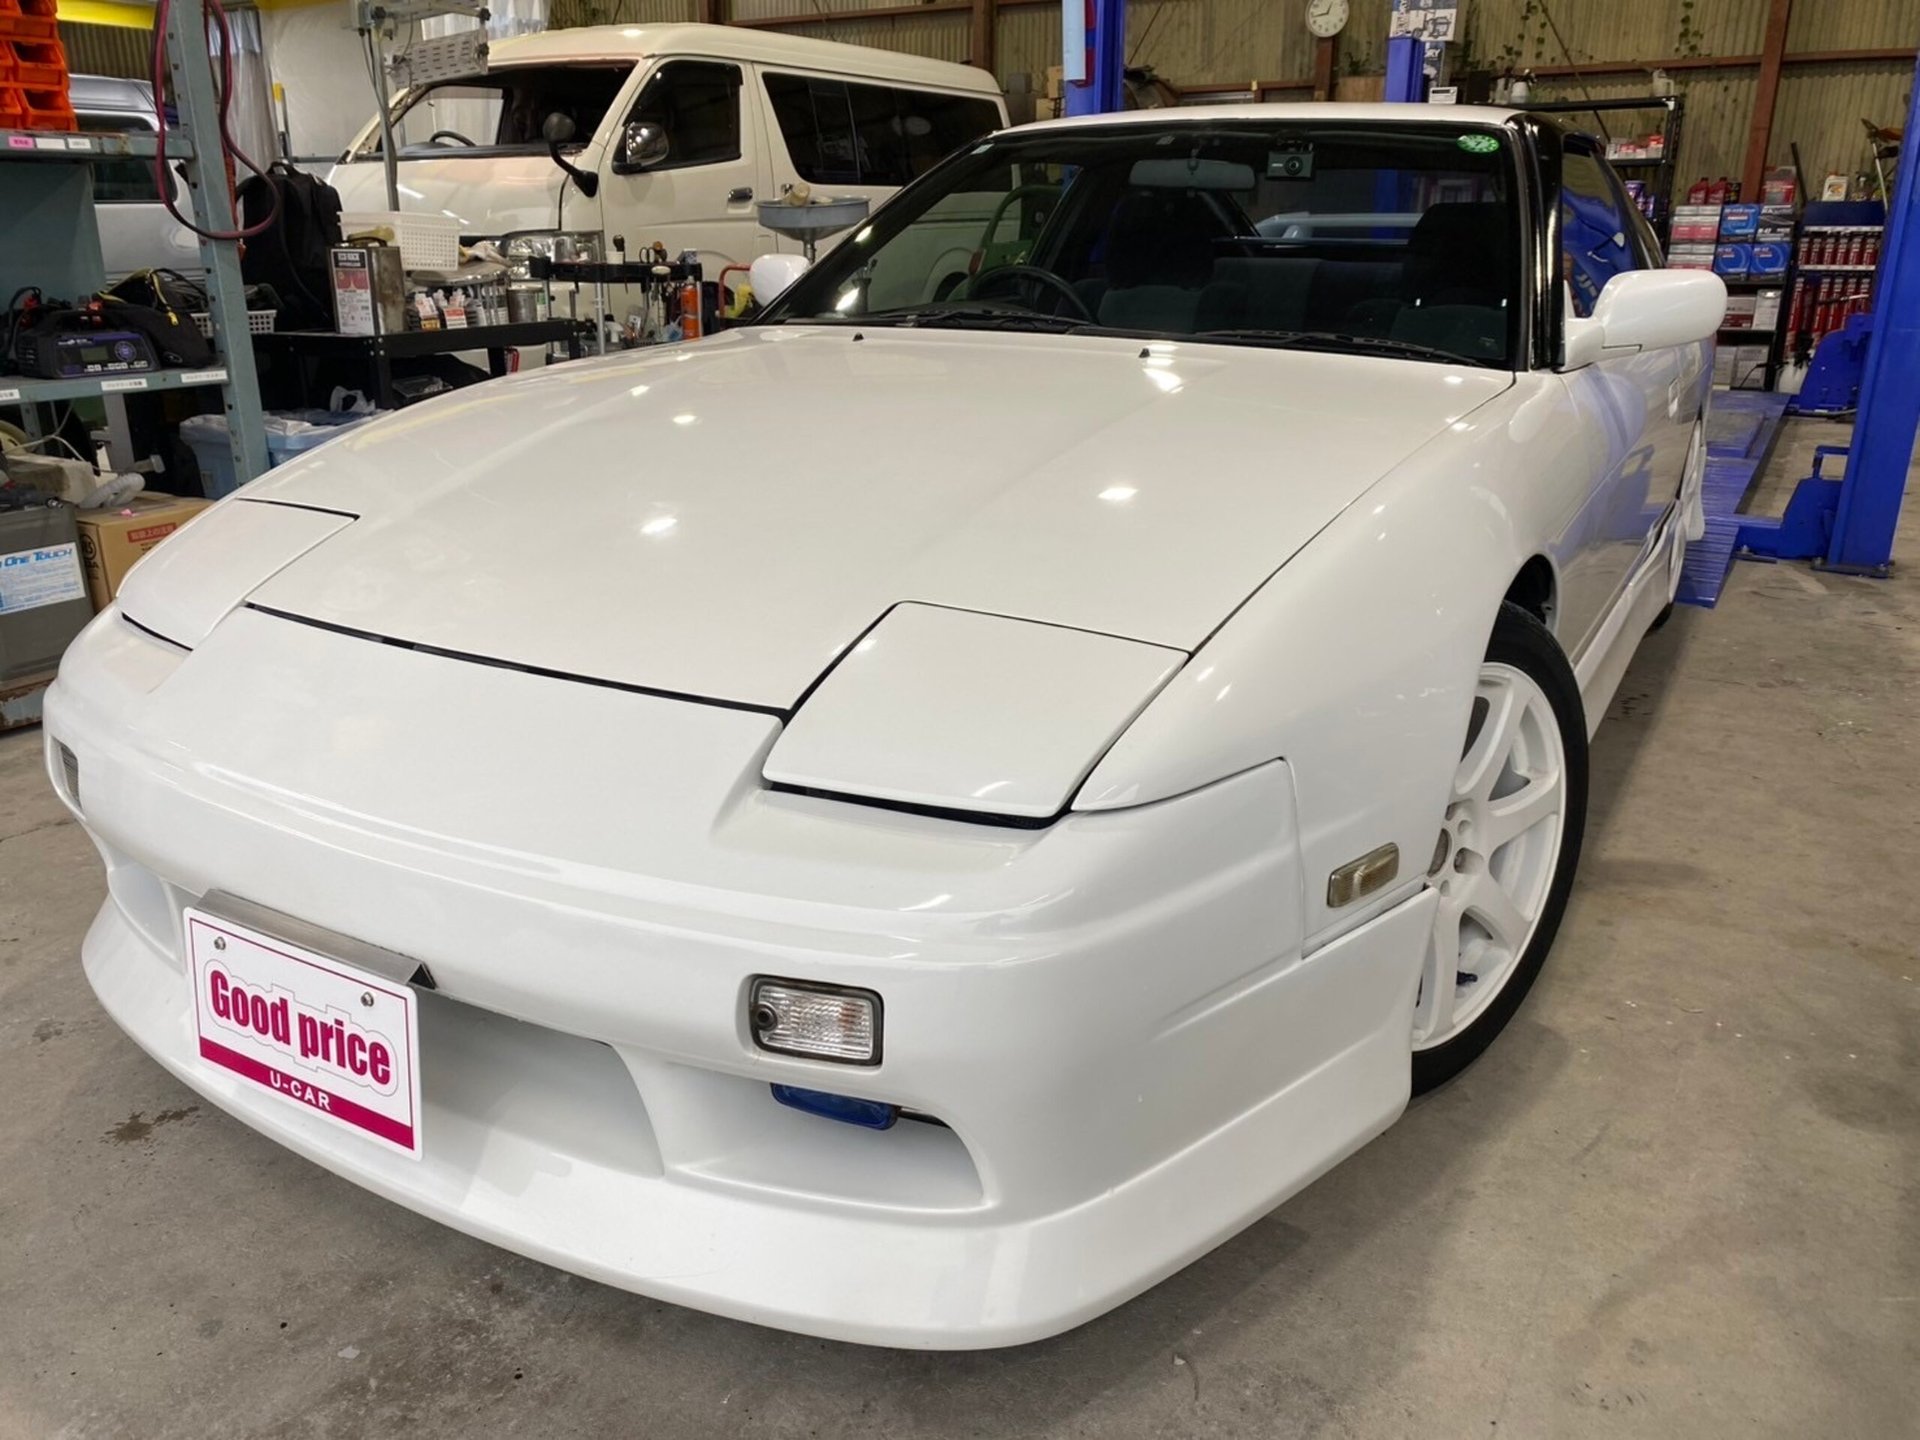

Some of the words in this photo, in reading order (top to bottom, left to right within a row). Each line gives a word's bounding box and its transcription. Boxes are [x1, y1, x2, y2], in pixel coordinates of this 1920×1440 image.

[211, 970, 291, 1046] Good
[298, 1012, 390, 1086] price
[270, 1070, 332, 1110] U-CAR
